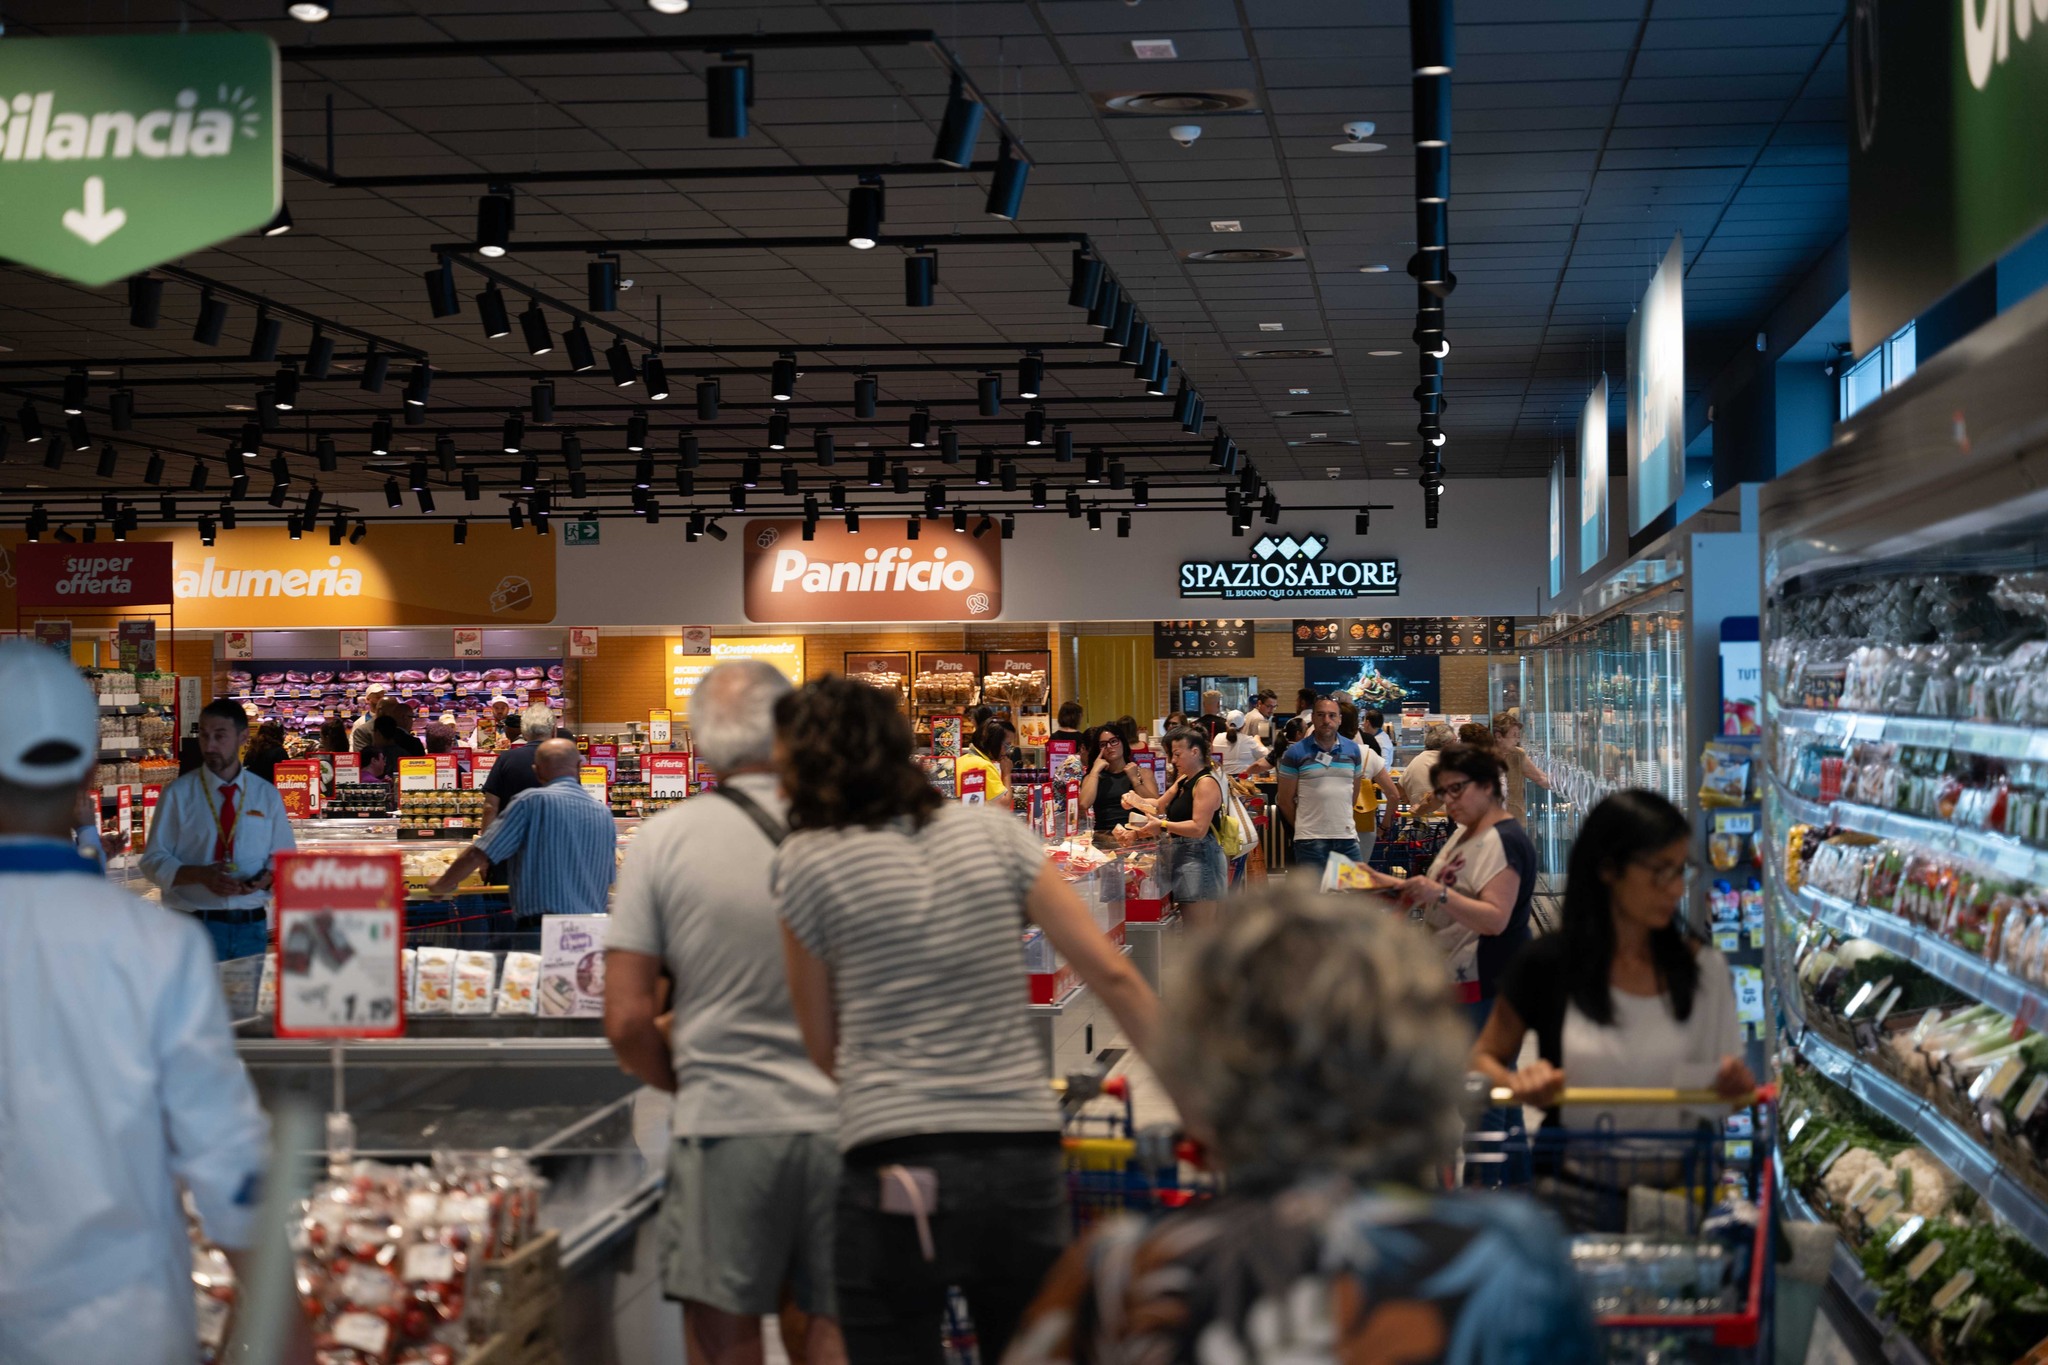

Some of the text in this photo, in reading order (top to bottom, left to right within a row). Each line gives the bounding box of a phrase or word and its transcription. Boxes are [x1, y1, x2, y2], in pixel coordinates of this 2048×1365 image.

[0, 89, 234, 160] ilancia
[66, 555, 133, 573] super
[771, 546, 975, 593] Panificio
[1181, 562, 1398, 588] SPAZIOSAPORE
[56, 573, 132, 595] offerta
[173, 556, 362, 599] alumeria
[1226, 588, 1354, 599] IL BUONO QUI O A PORTAR VIA
[936, 660, 963, 671] Pane
[1005, 659, 1032, 670] Pane
[655, 760, 683, 768] offerta
[292, 859, 389, 889] offerta
